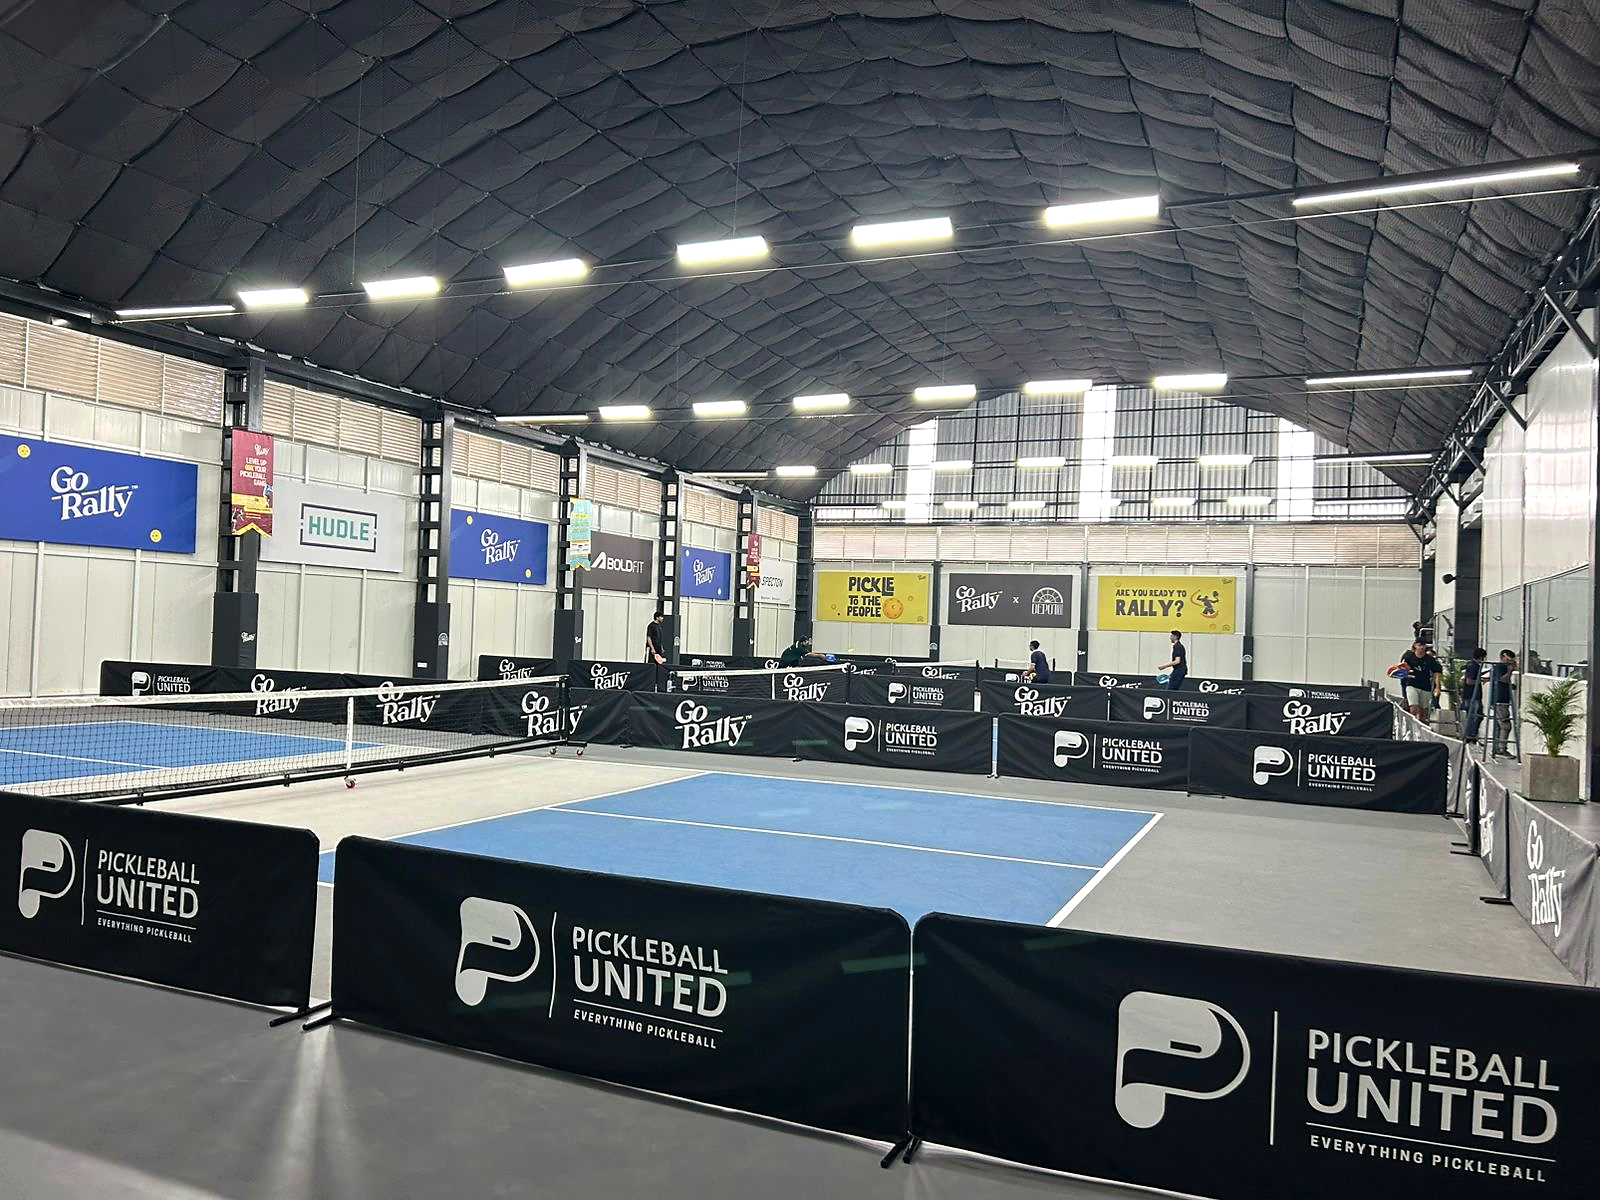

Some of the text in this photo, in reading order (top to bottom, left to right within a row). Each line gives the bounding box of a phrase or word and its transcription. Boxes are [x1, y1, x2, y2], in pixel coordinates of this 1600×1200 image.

[51, 466, 89, 493] Go
[308, 515, 370, 541] HUDLE
[481, 529, 498, 546] Go
[693, 559, 704, 573] Go
[848, 577, 895, 596] PICKLE
[956, 585, 976, 599] Go
[1132, 589, 1148, 597] YOU
[1176, 590, 1187, 598] TO
[861, 595, 881, 606] THE
[1115, 599, 1184, 618] RALLY?
[847, 606, 881, 617] PEOPLE
[500, 659, 515, 672] Go
[590, 663, 608, 677] Go
[764, 659, 780, 669] Go
[922, 666, 939, 678] Go
[156, 675, 190, 684] PICKLEBALL
[157, 682, 191, 693] UNITED
[251, 674, 274, 693] Go
[702, 680, 729, 688] UNITED
[783, 673, 804, 688] Go
[1099, 675, 1117, 687] Go
[1199, 680, 1219, 693] Go
[912, 691, 944, 701] UNITED
[1014, 686, 1039, 702] Go
[521, 691, 550, 714] Go
[1172, 700, 1209, 709] PICKLEBALL
[1283, 700, 1312, 718] Go
[675, 700, 708, 724] Go
[1172, 707, 1209, 718] UNITED
[886, 722, 938, 735] PICKLEBALL
[885, 731, 938, 748] UNITED
[1102, 737, 1163, 751] PICKLEBALL
[1101, 747, 1163, 765] UNITED
[1308, 753, 1376, 768] PICKLEBALL
[1307, 763, 1376, 782] UNITED
[1526, 819, 1544, 870] Go
[98, 849, 200, 885] PICKLEBALL
[97, 874, 199, 919] UNITED
[97, 917, 193, 944] EVERYTHING PICKLEBALL
[572, 926, 729, 975] PICKLEBALL
[574, 954, 728, 1018] UNITED
[573, 1009, 717, 1049] EVERYTHING PICKLEBALL
[1308, 1028, 1560, 1092] PICKLEBALL
[1306, 1066, 1559, 1145] UNITED
[1310, 1133, 1547, 1183] EVERYTHING PICKLEBALL
